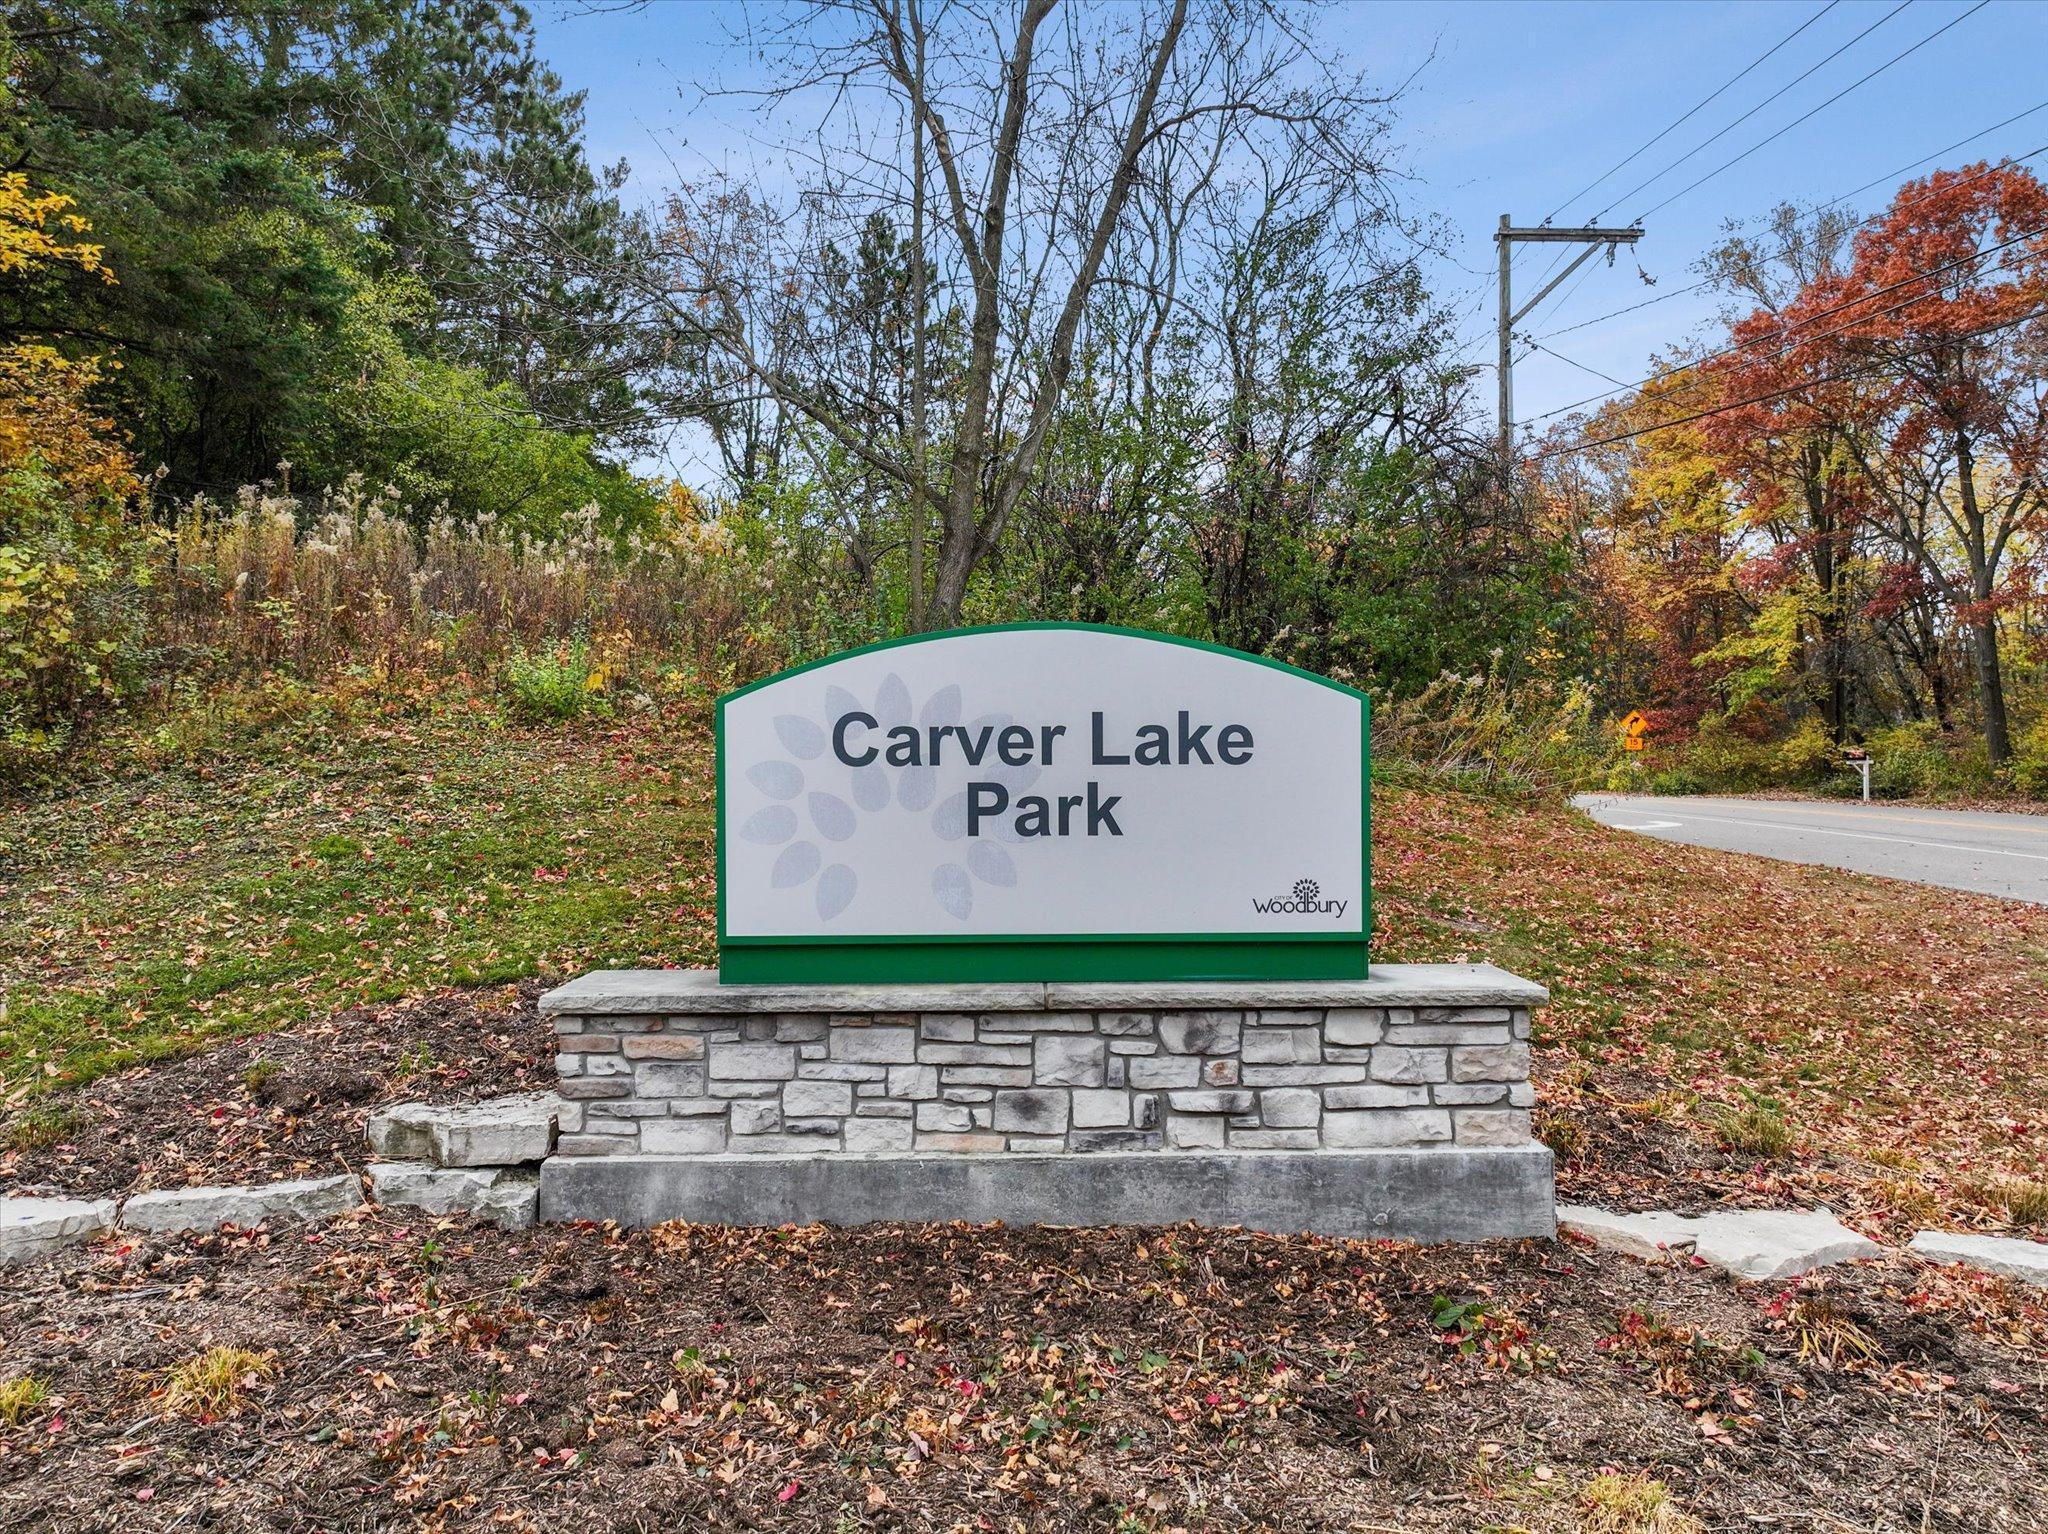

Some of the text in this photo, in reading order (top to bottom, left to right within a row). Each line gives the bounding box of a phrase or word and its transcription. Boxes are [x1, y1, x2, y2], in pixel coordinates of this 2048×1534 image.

[832, 710, 1254, 767] Carver Lake
[967, 781, 1124, 837] Park
[1252, 892, 1348, 918] Woodbury
